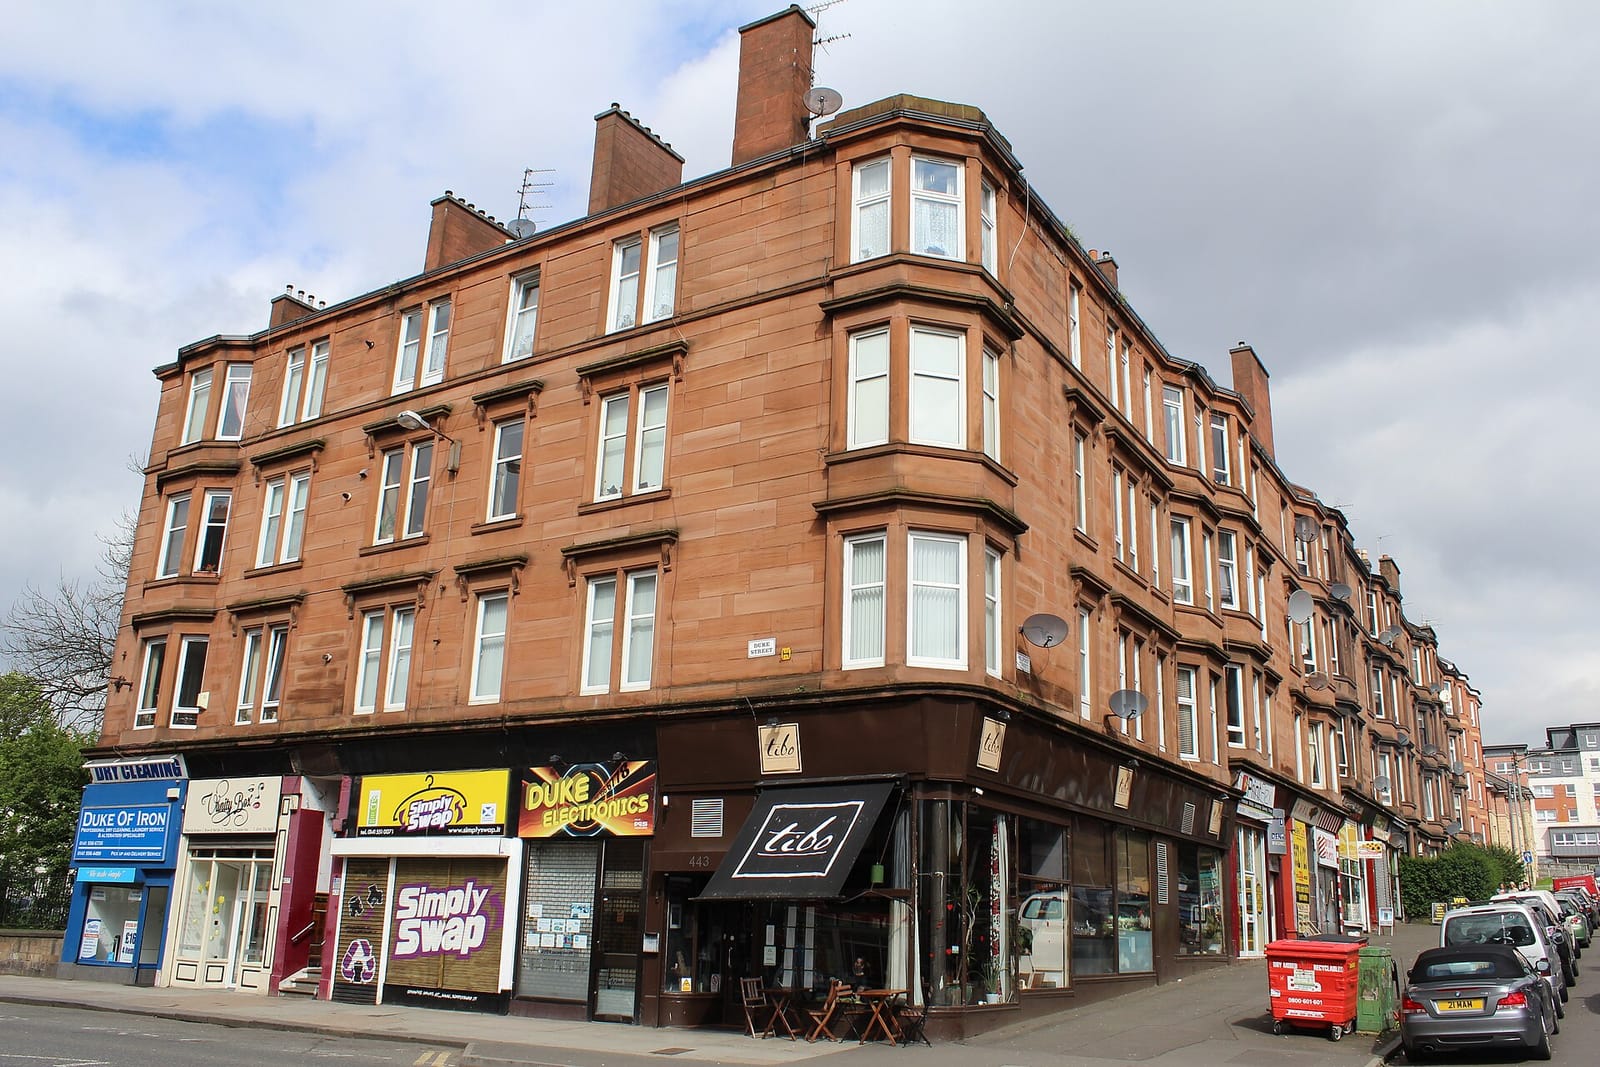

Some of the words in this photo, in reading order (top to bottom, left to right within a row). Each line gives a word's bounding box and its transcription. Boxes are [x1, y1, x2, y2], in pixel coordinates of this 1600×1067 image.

[766, 733, 795, 757] tibo
[95, 764, 120, 781] DRY
[121, 759, 182, 780] CLEANING
[525, 773, 590, 811] DUKE
[409, 795, 455, 815] Simply
[542, 793, 649, 828] ELECTRONICS
[82, 811, 115, 827] DUKE
[136, 810, 167, 826] IRON
[408, 809, 454, 831] Swap
[764, 815, 838, 853] tibo
[689, 856, 710, 867] 443
[396, 881, 489, 920] Simply
[395, 914, 487, 955] Swap
